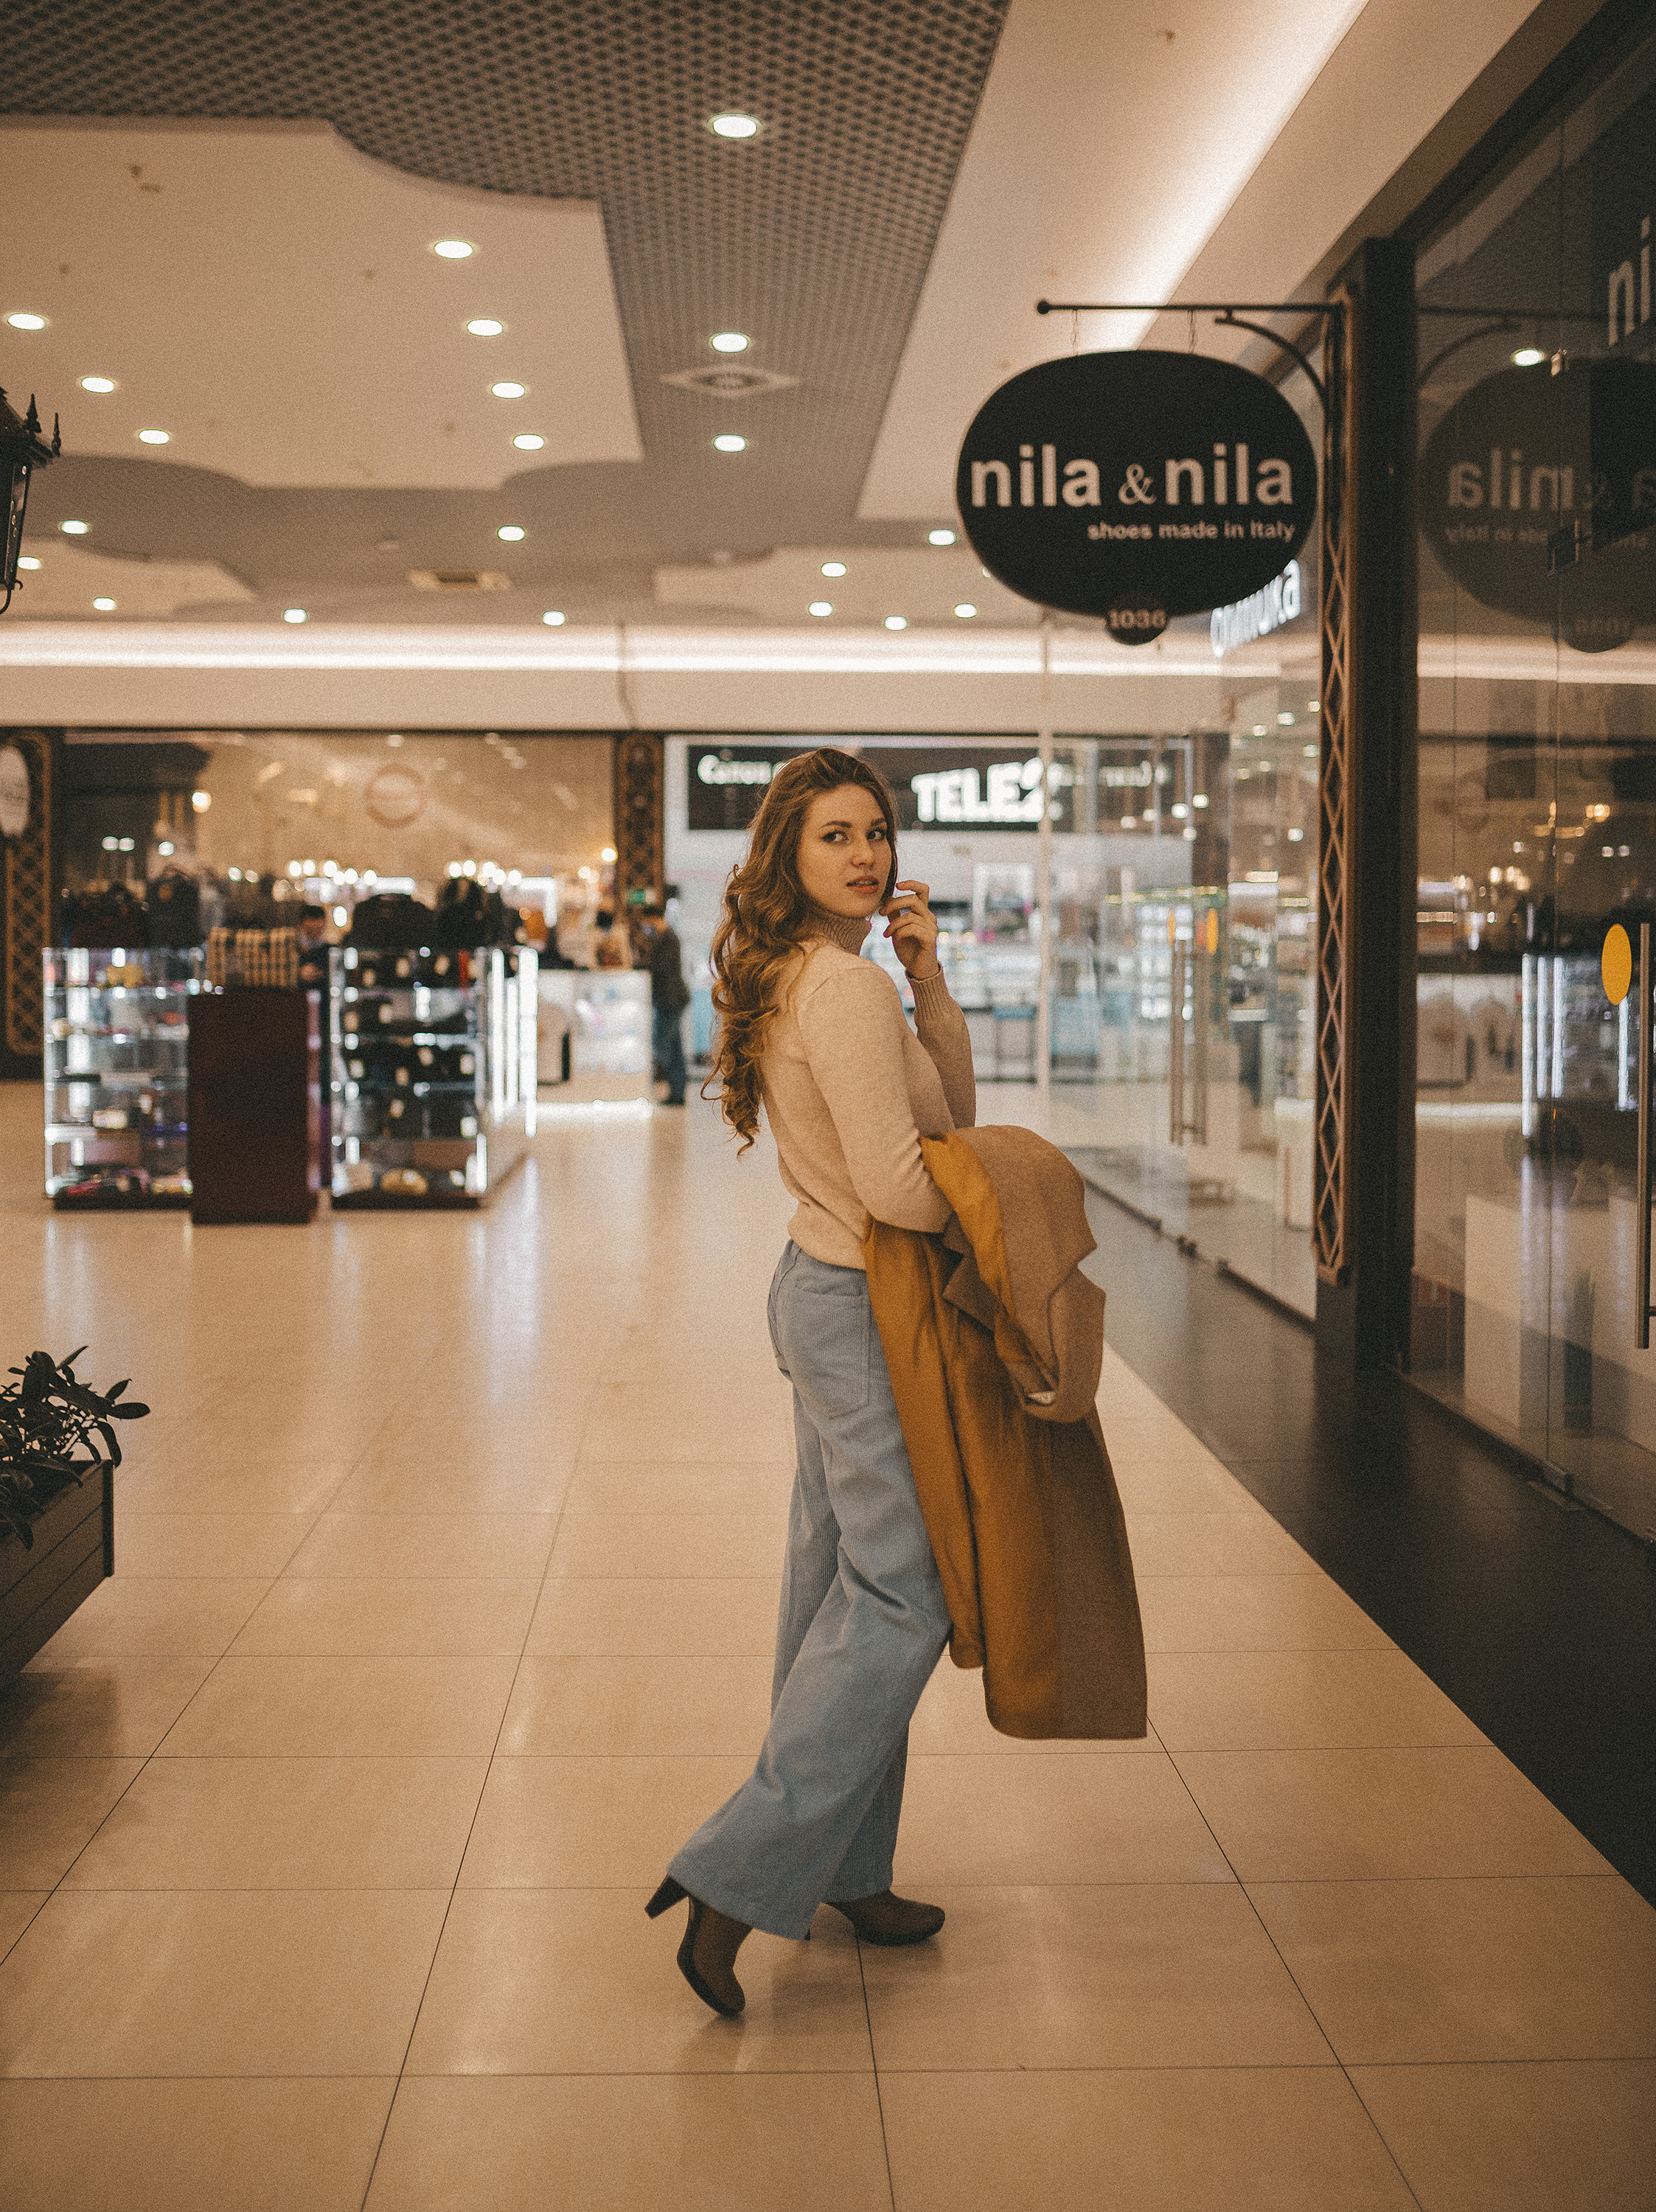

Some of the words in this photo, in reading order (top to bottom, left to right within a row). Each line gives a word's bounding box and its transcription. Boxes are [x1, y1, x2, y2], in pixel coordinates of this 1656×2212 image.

[971, 444, 1101, 507] nila
[1118, 463, 1156, 504] &
[1165, 443, 1293, 505] nila
[1088, 520, 1152, 540] shoes
[1158, 519, 1217, 539] made
[1224, 519, 1244, 539] in
[1250, 519, 1295, 543] Italy
